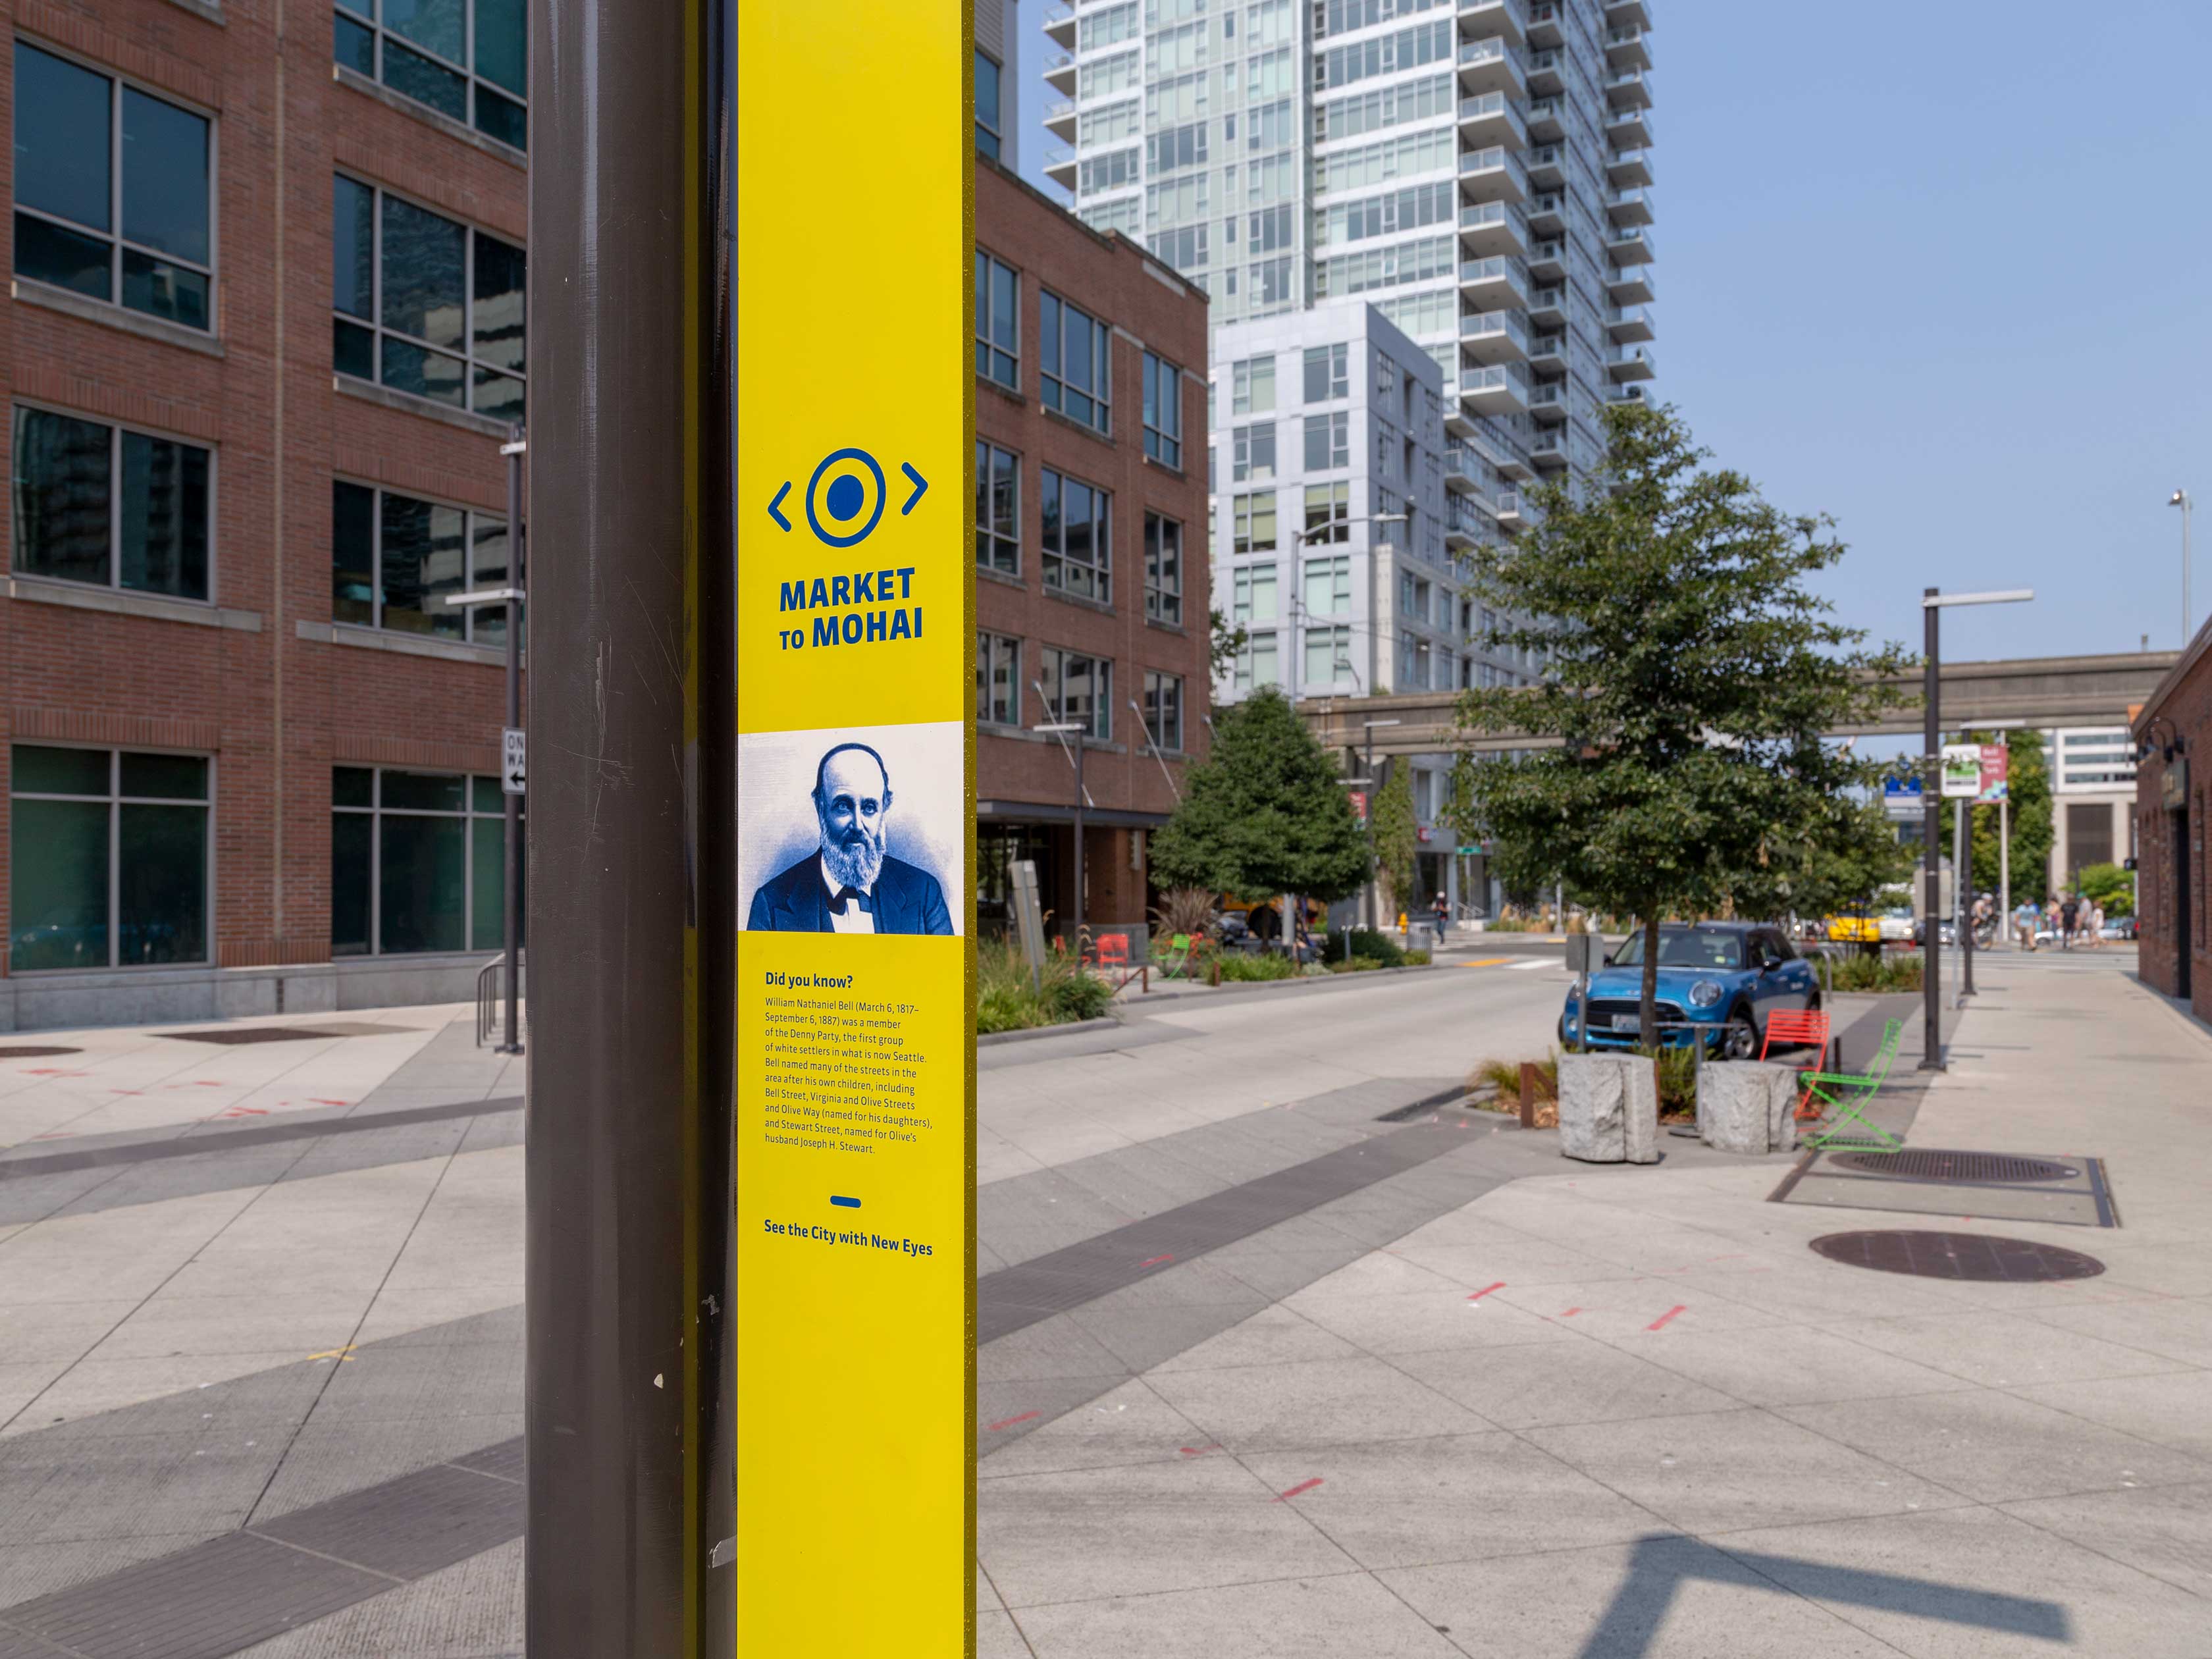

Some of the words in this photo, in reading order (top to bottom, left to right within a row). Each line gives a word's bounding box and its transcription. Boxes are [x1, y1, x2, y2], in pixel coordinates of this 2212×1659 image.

[780, 567, 915, 612] MARKET
[779, 629, 804, 650] TO
[812, 607, 922, 647] MOHAI
[507, 735, 525, 750] ON
[508, 753, 525, 767] WA
[766, 972, 785, 986] Did
[788, 976, 810, 989] you
[814, 973, 853, 989] know?
[765, 997, 795, 1007] William
[797, 999, 836, 1009] Nathaniel
[839, 1001, 853, 1011] Bell
[856, 1002, 884, 1012] (March
[887, 1003, 894, 1014] 6,
[765, 1012, 808, 1023] September
[810, 1014, 817, 1026] 6,
[819, 1015, 839, 1026] 1887)
[866, 1019, 901, 1029] member
[765, 1027, 773, 1036] of
[776, 1028, 788, 1038] the
[790, 1029, 815, 1041] Denny
[818, 1030, 841, 1043] Party,
[843, 1032, 856, 1042] the
[859, 1033, 876, 1043] first
[879, 1037, 903, 1047] group
[765, 1042, 774, 1051] of
[775, 1043, 797, 1053] white
[799, 1045, 830, 1055] settlers
[841, 1048, 862, 1058] what
[865, 1049, 871, 1059] is
[893, 1051, 926, 1063] Seattle.
[766, 1057, 779, 1067] Bell
[781, 1061, 808, 1069] named
[810, 1063, 832, 1074] many
[834, 1063, 842, 1072] of
[845, 1064, 858, 1073] the
[860, 1066, 889, 1076] streets
[902, 1068, 916, 1078] the
[783, 1074, 803, 1084] after
[805, 1076, 817, 1086] his
[837, 1079, 873, 1092] children,
[876, 1082, 915, 1096] including
[766, 1088, 779, 1097] Bell
[781, 1090, 808, 1102] Street,
[810, 1092, 841, 1104] Virginia
[843, 1095, 858, 1105] and
[861, 1096, 882, 1107] Olive
[883, 1098, 915, 1110] Streets
[765, 1104, 779, 1113] and
[781, 1105, 801, 1115] Olive
[803, 1107, 820, 1119] Way
[822, 1109, 852, 1120] (named
[855, 1111, 866, 1121] for
[869, 1113, 881, 1122] his
[883, 1114, 932, 1129] daughters),
[765, 1119, 779, 1128] and
[781, 1120, 812, 1132] Stewart
[815, 1123, 843, 1136] Street,
[845, 1128, 872, 1138] named
[875, 1129, 887, 1139] for
[889, 1130, 916, 1142] Olive's
[765, 1133, 799, 1146] husband
[800, 1138, 827, 1149] Joseph
[830, 1140, 837, 1149] H.
[839, 1141, 875, 1154] Stewart.
[764, 1219, 785, 1234] See
[788, 1223, 808, 1238] the
[811, 1226, 836, 1245] City
[839, 1231, 867, 1246] with
[872, 1234, 899, 1251] New
[903, 1239, 932, 1257] Eyes
